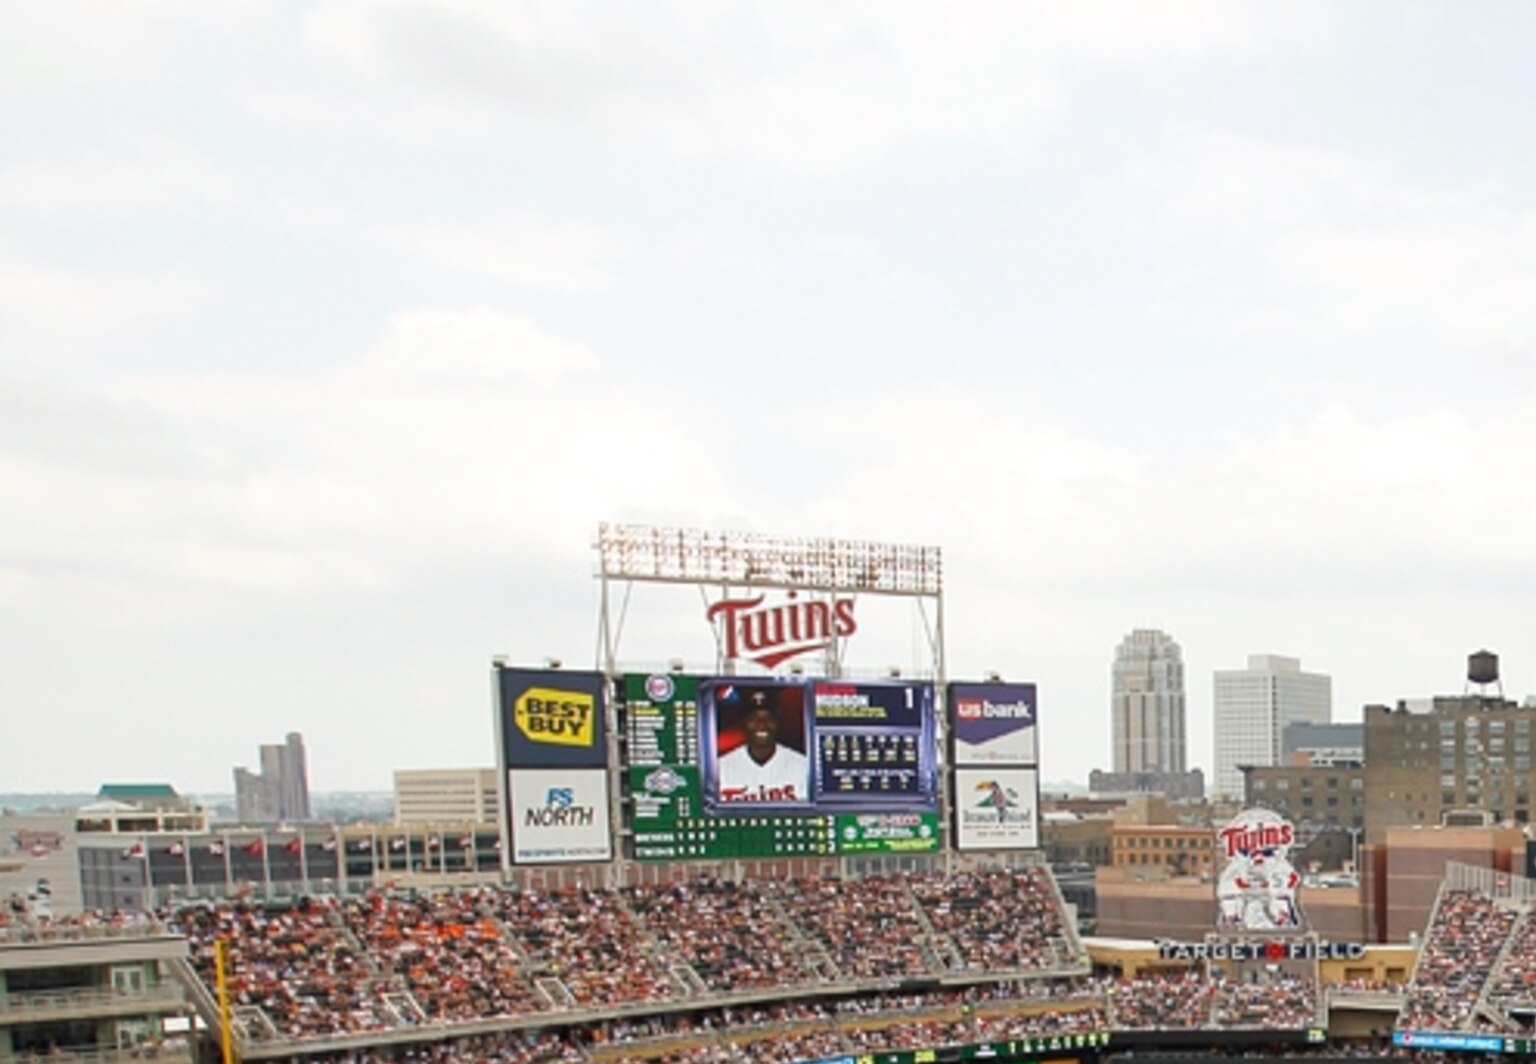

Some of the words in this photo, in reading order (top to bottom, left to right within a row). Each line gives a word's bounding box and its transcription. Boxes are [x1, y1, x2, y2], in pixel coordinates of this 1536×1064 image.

[707, 588, 857, 658] Twins
[526, 697, 590, 718] BEST
[528, 716, 585, 736] BUY
[524, 806, 594, 826] NORTH
[1220, 822, 1292, 857] Twins
[1161, 943, 1263, 960] TARGET
[1290, 942, 1365, 960] FIELD
